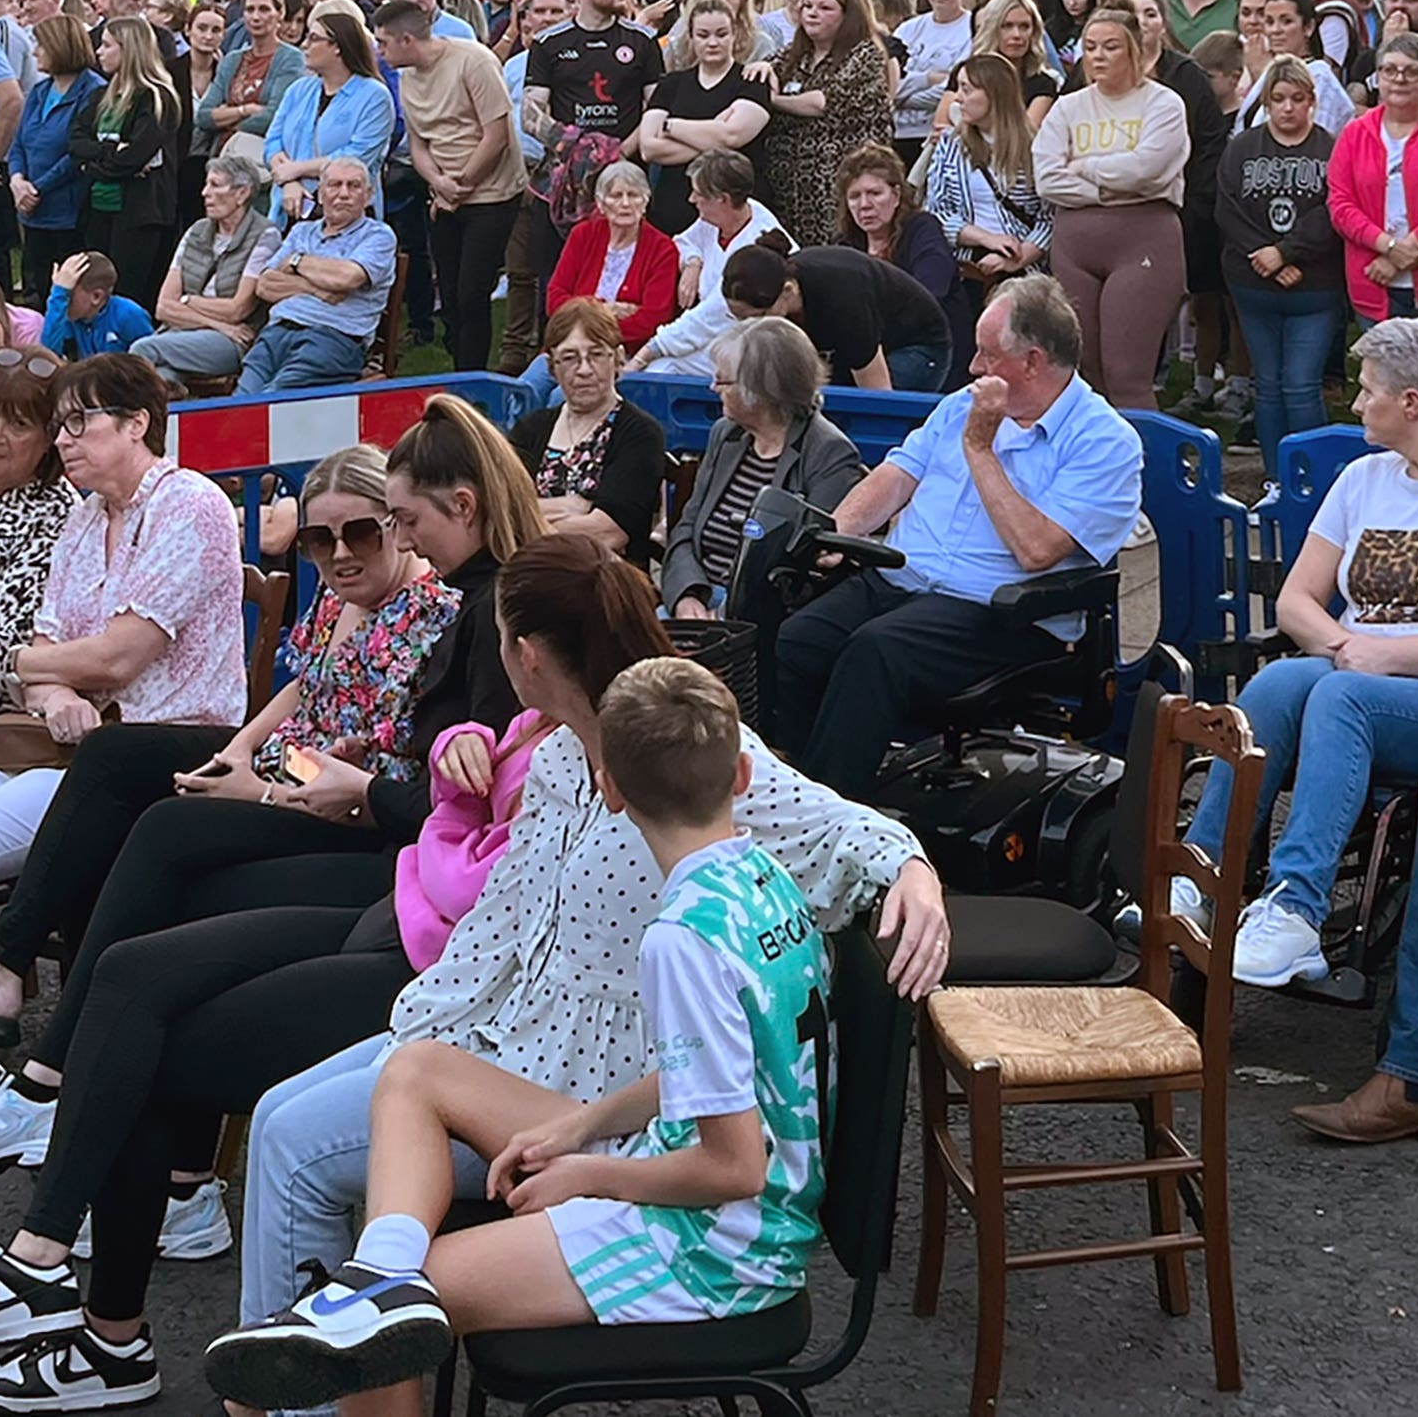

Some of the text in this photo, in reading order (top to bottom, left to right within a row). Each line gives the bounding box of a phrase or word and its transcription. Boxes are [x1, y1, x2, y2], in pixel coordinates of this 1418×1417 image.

[575, 103, 619, 118] tyrone
[1076, 118, 1143, 153] OUT
[672, 1034, 705, 1050] Cup
